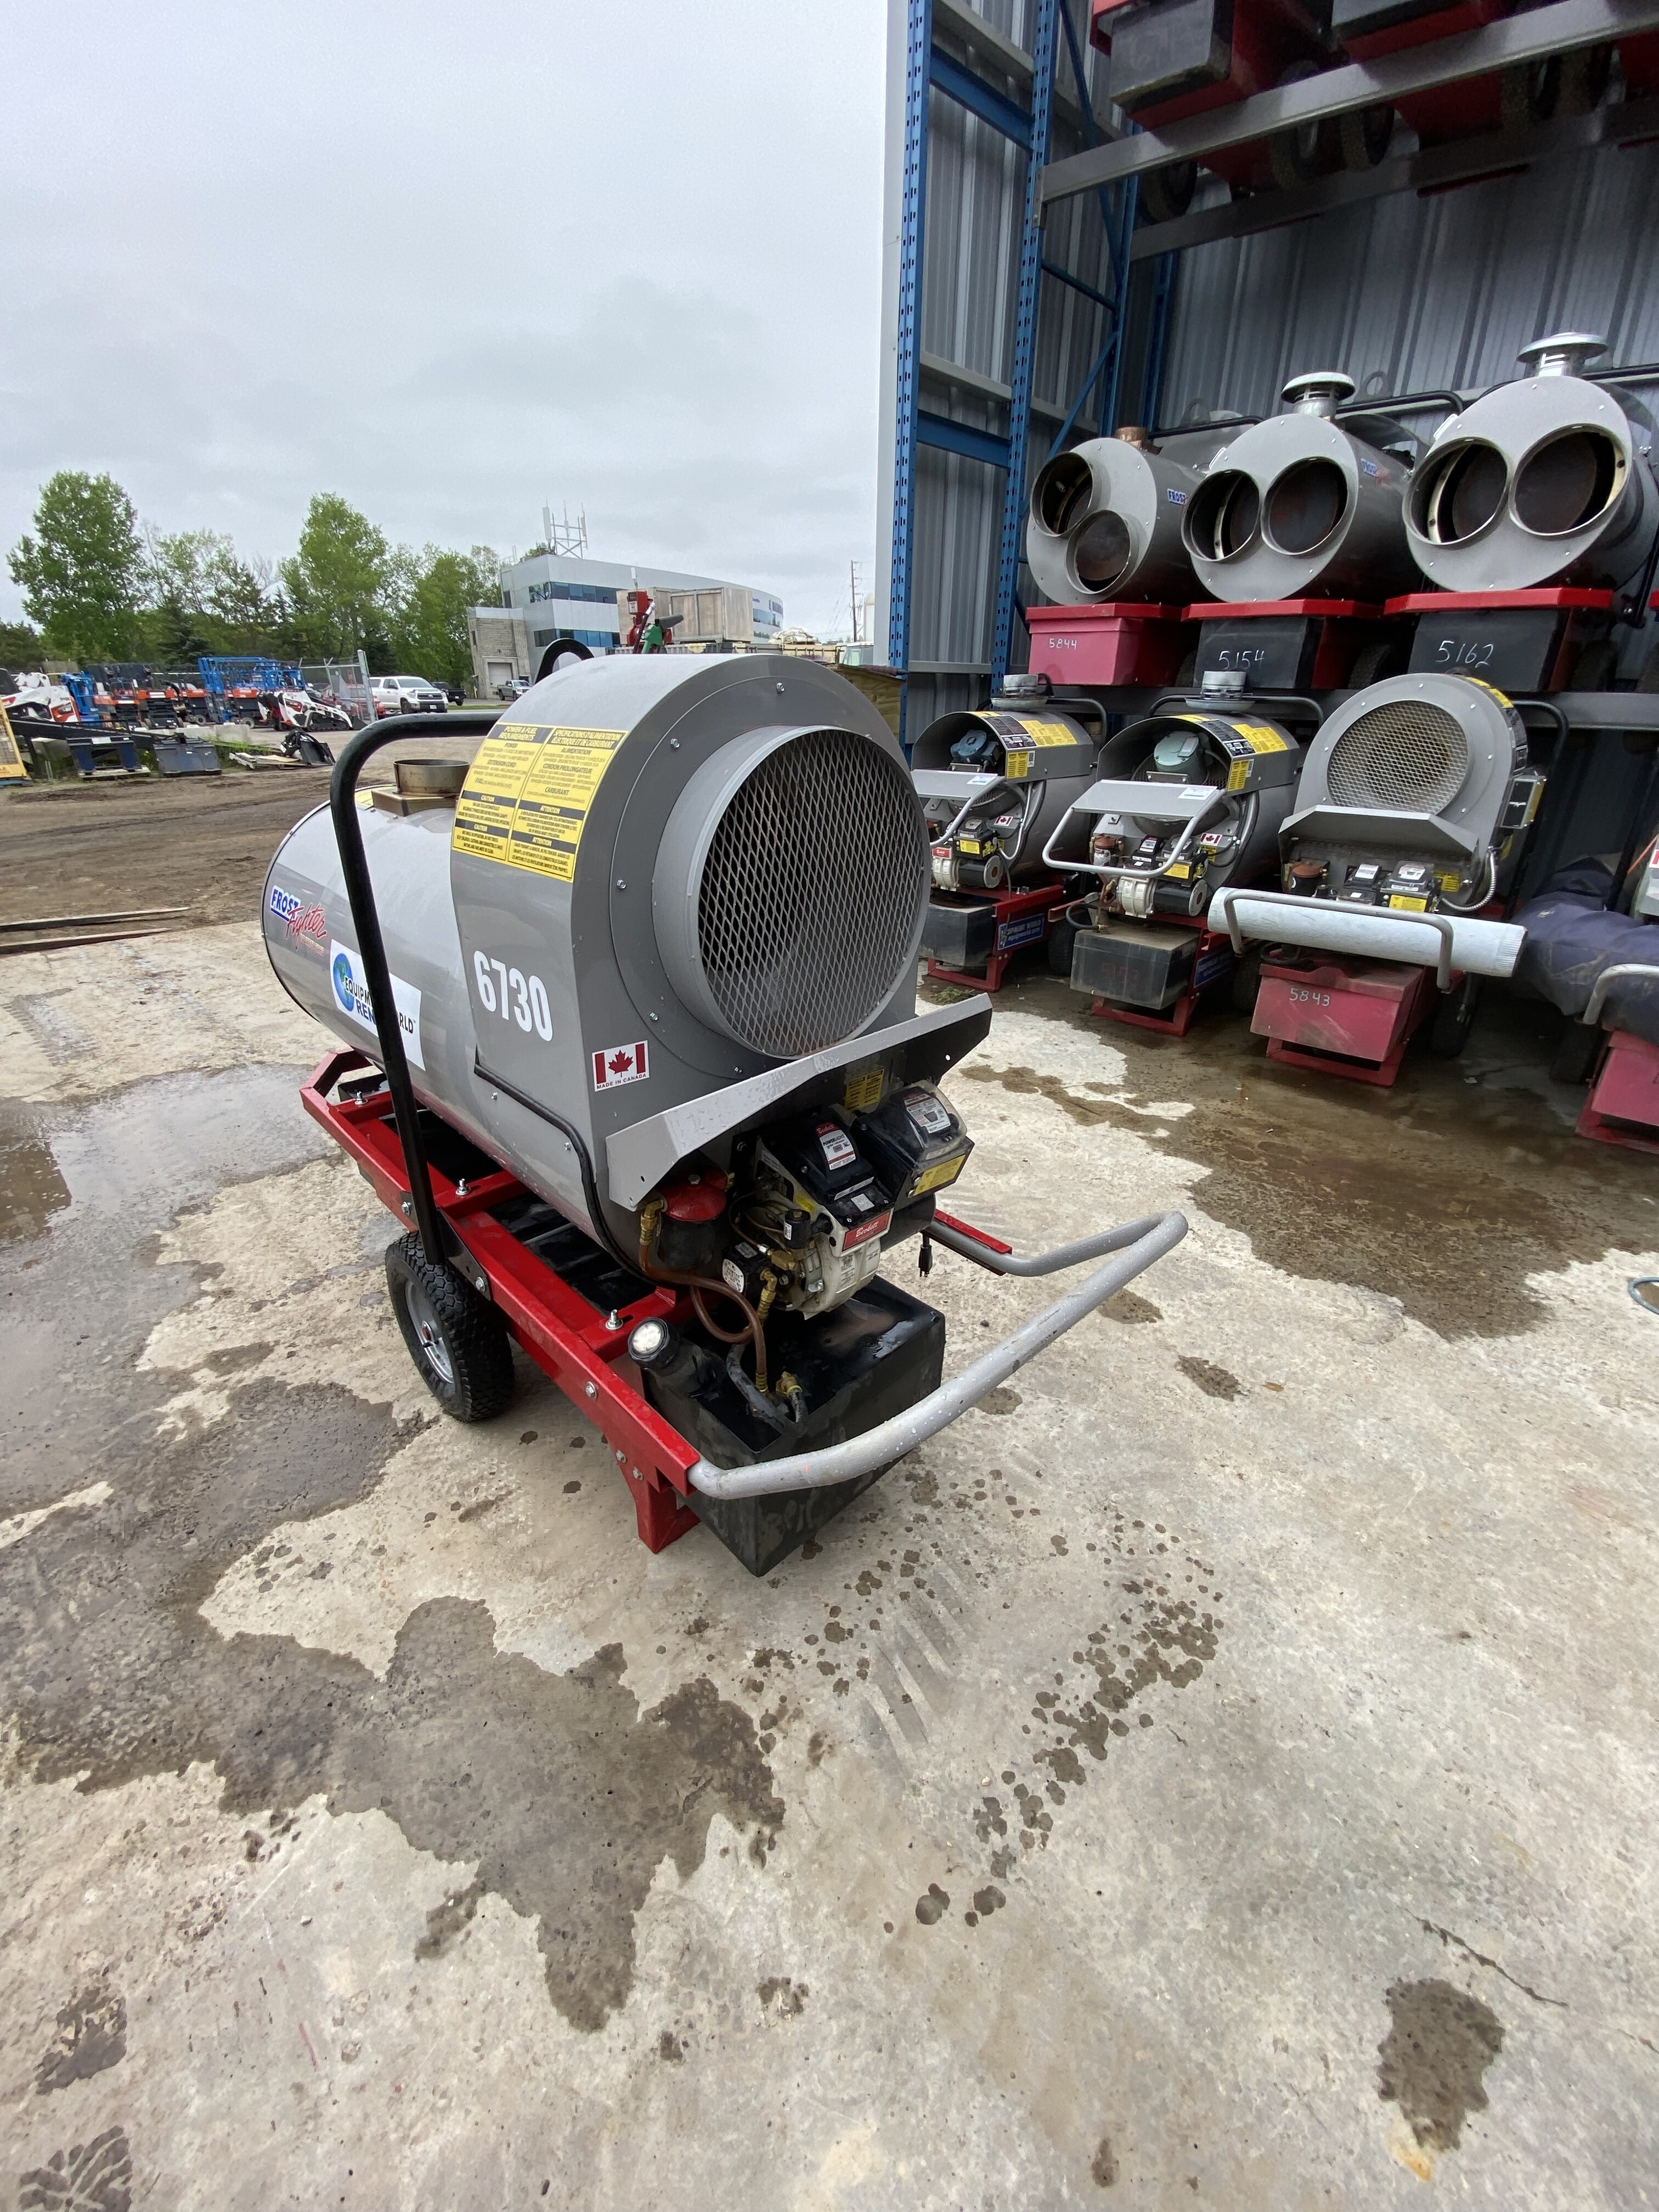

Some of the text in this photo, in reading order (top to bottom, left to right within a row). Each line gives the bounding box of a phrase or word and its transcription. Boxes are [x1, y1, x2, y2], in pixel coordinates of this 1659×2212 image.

[1049, 637, 1077, 650] 5844
[1435, 640, 1493, 668] 5162
[1218, 650, 1265, 670] 5154
[271, 888, 300, 919] FROST
[285, 903, 327, 950] Fighter
[345, 977, 371, 1006] EQUIPM
[474, 950, 553, 1041] 6730
[1289, 988, 1330, 1006] 5843
[356, 998, 414, 1034] REN RLD
[596, 1081, 613, 1090] MADE
[623, 1073, 646, 1082] CANADA
